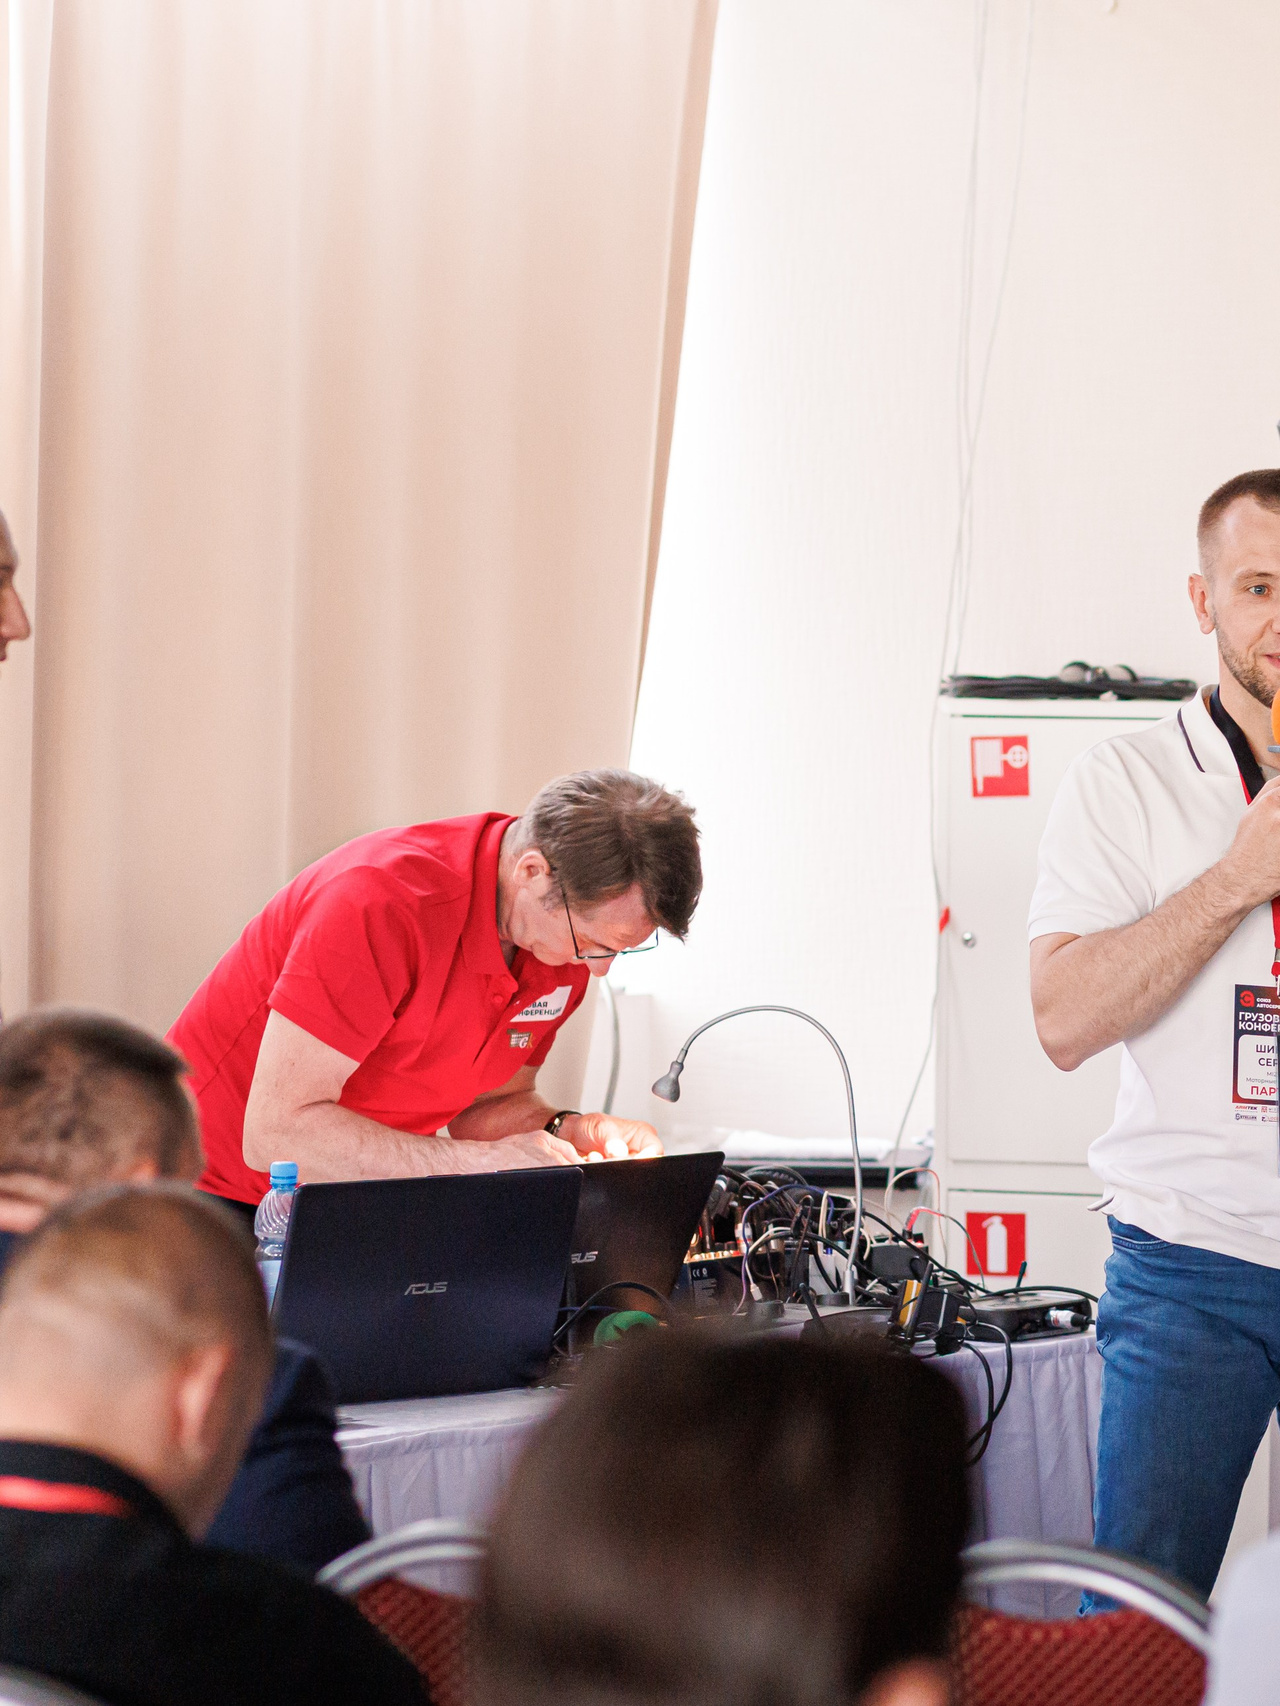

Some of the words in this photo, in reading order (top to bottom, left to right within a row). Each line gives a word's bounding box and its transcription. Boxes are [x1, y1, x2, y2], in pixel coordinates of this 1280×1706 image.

[1256, 1044, 1275, 1053] ШИ
[1258, 1058, 1278, 1067] СЕР
[1250, 1085, 1277, 1096] ПАР
[404, 1281, 448, 1296] ASUS
